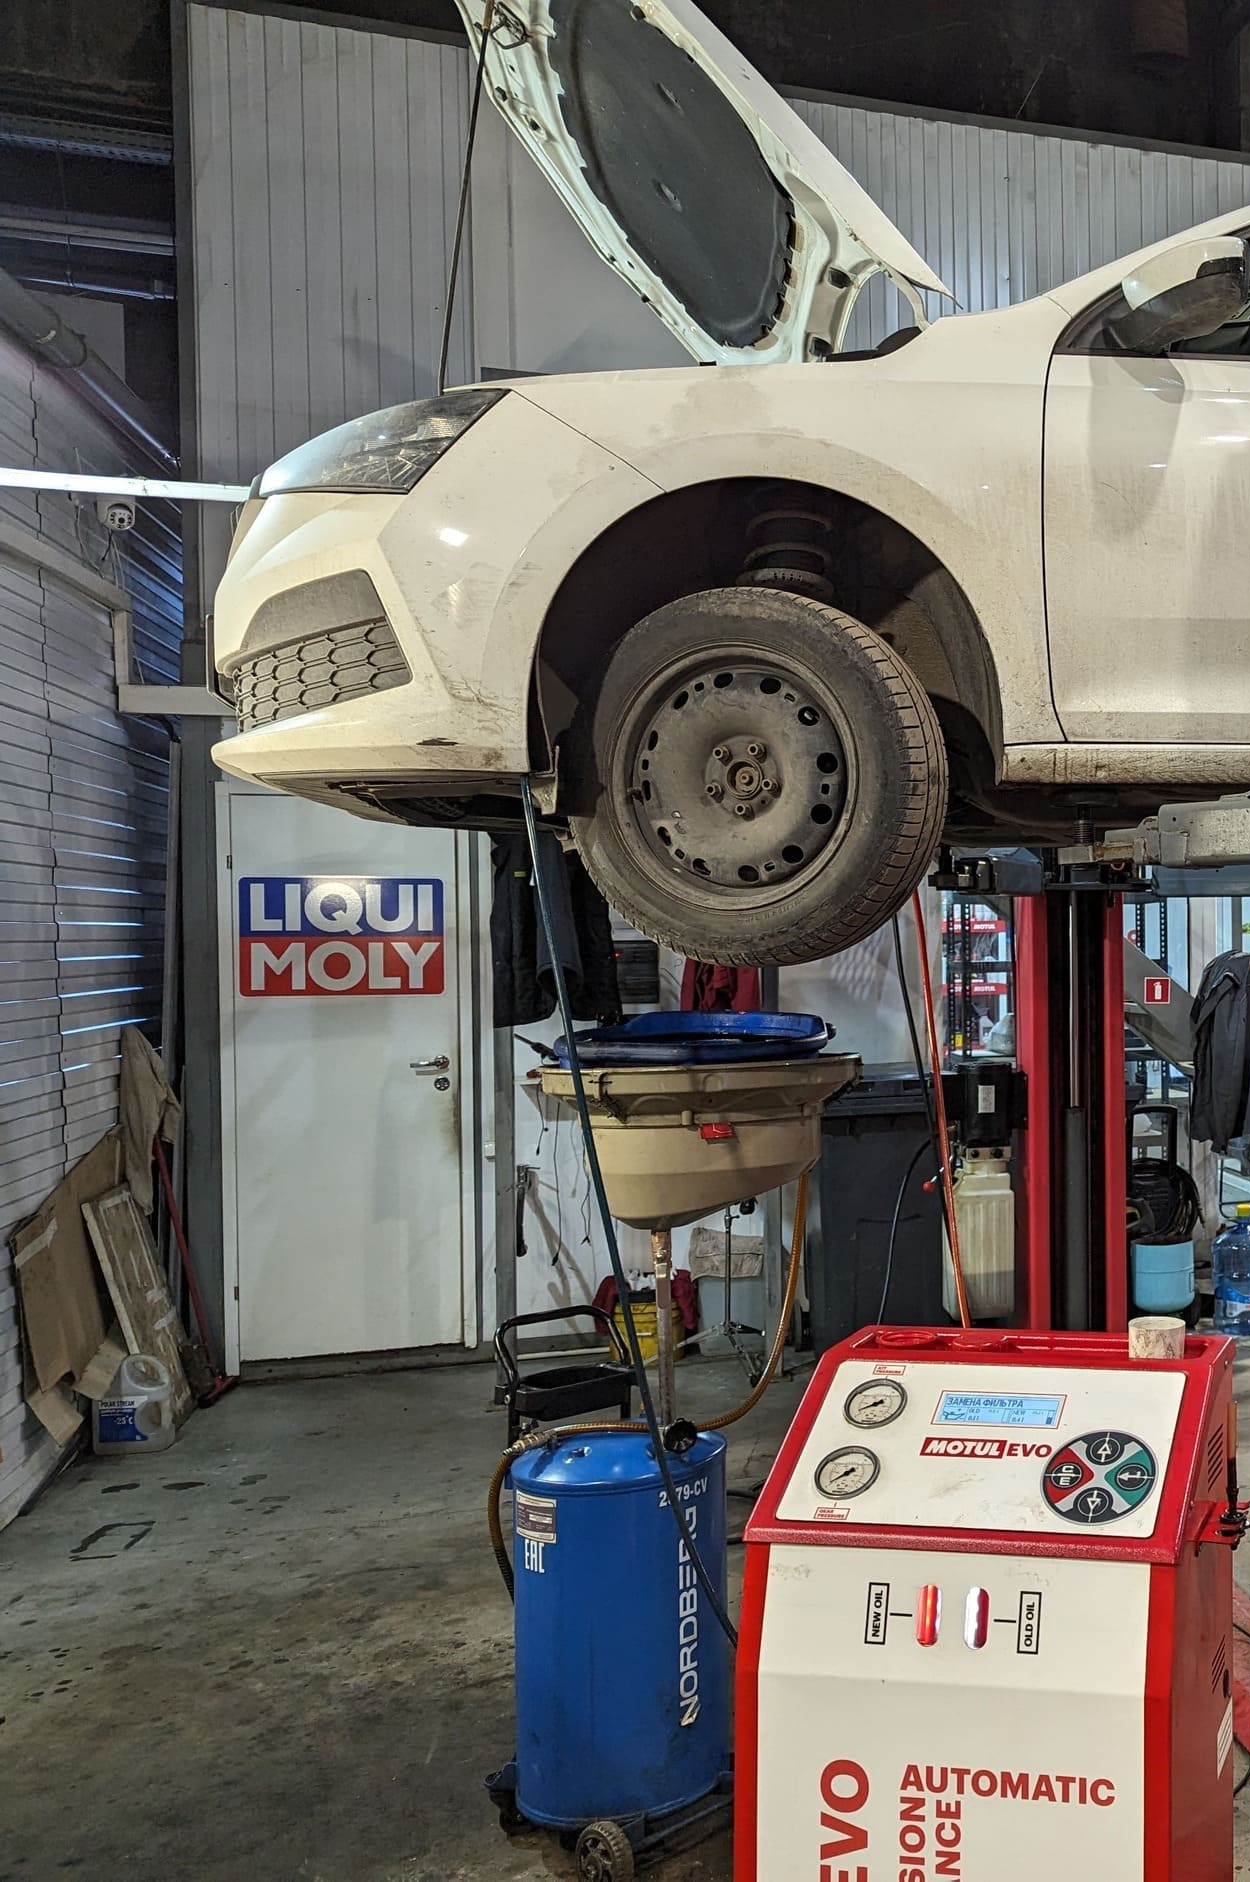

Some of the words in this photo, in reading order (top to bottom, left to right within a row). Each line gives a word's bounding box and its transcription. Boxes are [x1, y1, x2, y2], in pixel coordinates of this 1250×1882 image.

[250, 882, 434, 935] LIQUI
[250, 940, 441, 991] MOLY
[947, 1397, 981, 1406] ЗАМЕНА
[982, 1399, 1024, 1408] ФИЛЬТРА
[925, 1440, 1001, 1456] MOTUL
[1006, 1443, 1052, 1458] EVO
[658, 1476, 708, 1508] 279-CV
[524, 1538, 545, 1574] EAC
[875, 1590, 884, 1609] OIL
[1026, 1602, 1036, 1621] OIL
[872, 1612, 882, 1638] NEW
[1024, 1623, 1034, 1647] OLD
[900, 1764, 1116, 1807] AUTOMATIC
[935, 1800, 962, 1882] NCE
